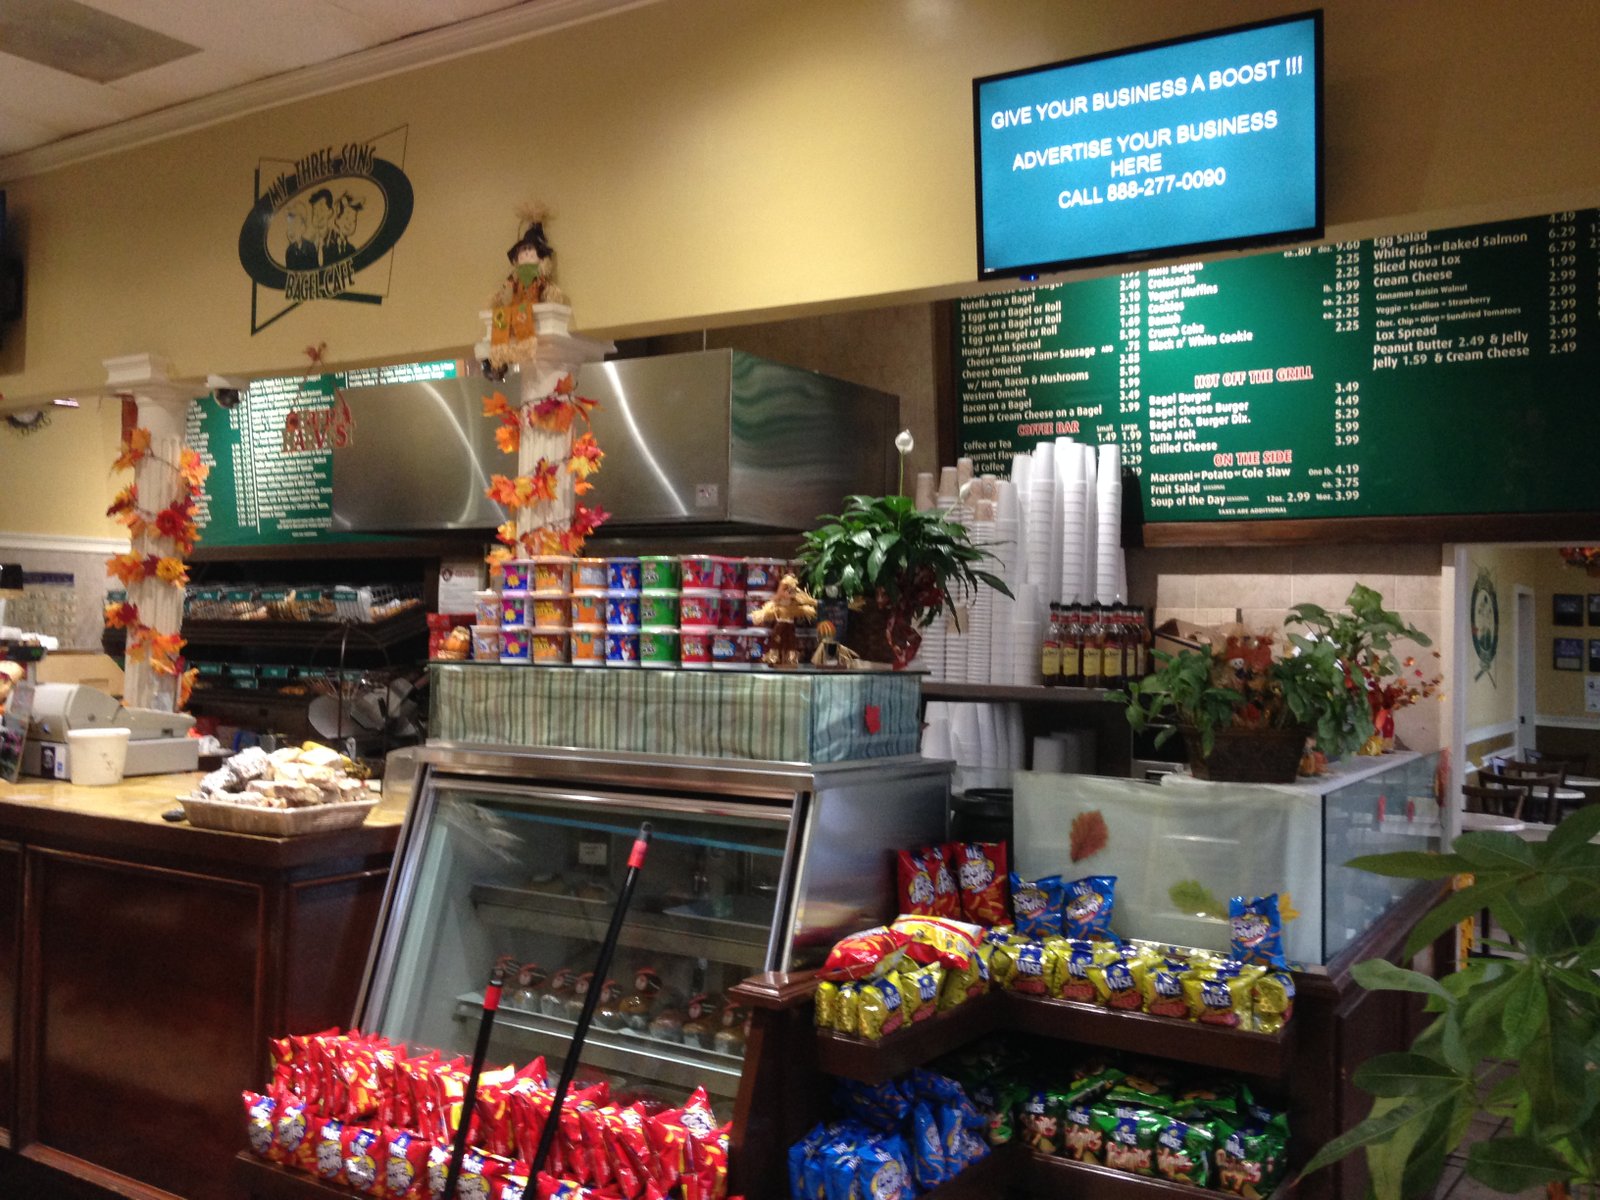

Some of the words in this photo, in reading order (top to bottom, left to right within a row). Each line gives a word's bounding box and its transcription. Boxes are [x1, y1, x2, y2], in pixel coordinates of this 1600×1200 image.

[991, 107, 1032, 130] GIVE
[1036, 96, 1088, 120] YOUR
[1092, 78, 1186, 112] BUSINESS
[1190, 74, 1204, 94] A
[1209, 59, 1280, 90] BOOST
[1286, 56, 1303, 77] !!!
[1012, 138, 1112, 171] ADVERTISE
[1117, 128, 1172, 154] YOUR
[1177, 110, 1278, 144] BUSINESS
[294, 146, 334, 190] THREE
[340, 143, 376, 175] SONS
[1111, 153, 1162, 178] HERE
[1058, 186, 1102, 210] CALL
[1107, 167, 1226, 202] 888-277-0090
[1374, 247, 1406, 260] White
[1410, 244, 1432, 256] Fish
[1443, 239, 1479, 252] Baked
[1483, 232, 1528, 247] Salmon
[1549, 226, 1575, 239] 6.29
[1374, 262, 1406, 274] Sliced
[1410, 258, 1438, 270] Nova
[1441, 256, 1461, 266] Lox
[1549, 241, 1575, 253] 6.79
[1148, 274, 1196, 289] Croissants
[1336, 253, 1360, 265] 2.25
[1374, 275, 1408, 287] Cream
[1412, 270, 1452, 284] Cheese
[1550, 255, 1576, 268] 1.99
[286, 270, 322, 300] BAGEL
[1148, 288, 1179, 303] Yogurt
[1181, 284, 1218, 298] Muffins
[1336, 267, 1360, 279] 2.25
[1148, 301, 1185, 314] Cookies
[1336, 280, 1360, 292] 8.99
[1376, 290, 1413, 301] Cinnamon
[1416, 287, 1439, 297] Raisin
[1441, 284, 1468, 294] Walnut
[1549, 270, 1576, 282] 2.99
[961, 300, 989, 311] Nutella
[1011, 292, 1035, 305] Bagel
[1008, 304, 1032, 317] Bagel
[1045, 300, 1062, 312] Roll
[1148, 313, 1181, 327] Danish
[1336, 293, 1359, 306] 2.25
[1376, 304, 1401, 315] Veggie
[1410, 301, 1439, 310] Scallion
[1448, 296, 1490, 308] Strawberry
[1549, 284, 1576, 296] 2.99
[1008, 316, 1032, 329] Bagel
[1045, 312, 1062, 324] Roll
[1148, 325, 1179, 339] Crumb
[1181, 322, 1205, 336] Cake
[1336, 307, 1359, 319] 2.25
[1376, 319, 1395, 328] Choc.
[1397, 316, 1414, 327] Chip
[1420, 314, 1439, 324] Olive
[1446, 310, 1481, 321] Sundried
[1484, 306, 1521, 316] Tomatoes
[1549, 299, 1576, 311] 2.99
[1004, 328, 1028, 341] Bagel
[1041, 324, 1057, 336] Roll
[1148, 338, 1174, 352] Black
[1188, 334, 1217, 347] White
[1219, 330, 1253, 343] Cookie
[1336, 320, 1359, 332] 2.25
[1376, 330, 1395, 341] Lox
[1398, 324, 1437, 338] Spread
[1549, 313, 1576, 325] 3.49
[962, 346, 990, 358] Hungry
[992, 344, 1010, 353] Man
[1012, 340, 1041, 353] Special
[1374, 343, 1413, 355] Peanut
[1417, 338, 1452, 350] Butter
[1458, 336, 1484, 348] 2.49
[1502, 331, 1528, 345] Jelly
[1549, 328, 1576, 340] 2.99
[966, 357, 994, 367] Cheese
[1001, 354, 1026, 364] Bacon
[1033, 351, 1052, 361] Ham
[1060, 346, 1095, 359] Sausage
[1373, 356, 1398, 370] Jelly
[1402, 355, 1427, 366] 1.59
[1435, 353, 1443, 363] &
[1446, 349, 1483, 363] Cream
[1487, 346, 1530, 359] Cheese
[1550, 342, 1576, 354] 2.49
[962, 368, 989, 379] Cheese
[992, 366, 1022, 376] Omelet
[981, 377, 1002, 389] Ham,
[1005, 376, 1029, 386] Bacon
[1040, 371, 1089, 383] Mushrooms
[1194, 374, 1220, 389] HOT
[1223, 372, 1247, 387] OFF
[1249, 370, 1273, 384] THE
[1276, 366, 1313, 382] GRILL
[963, 391, 994, 402] Western
[996, 389, 1026, 399] Omelet
[963, 403, 986, 412] Bacon
[1009, 398, 1031, 411] Bagel
[1149, 394, 1176, 407] Bagel
[1178, 392, 1211, 405] Burger
[1335, 382, 1359, 394] 3.49
[963, 414, 986, 424] Bacon
[997, 412, 1022, 421] Cream
[1024, 409, 1054, 420] Cheese
[1077, 404, 1102, 417] Bagel
[1149, 406, 1176, 419] Bagel
[1178, 404, 1212, 416] Cheese
[1215, 402, 1249, 415] Burger
[1335, 395, 1359, 406] 4.49
[1056, 421, 1080, 434] BAR
[1149, 419, 1176, 432] Bagel
[1196, 415, 1229, 428] Burger
[1335, 408, 1359, 420] 5.29
[1149, 432, 1172, 443] Tuna
[1175, 429, 1196, 441] Melt
[1335, 422, 1359, 433] 5.99
[964, 440, 989, 450] Coffee
[999, 440, 1012, 448] Tea
[1150, 443, 1181, 455] Grilled
[1183, 442, 1217, 453] Cheese
[1335, 435, 1359, 446] 3.99
[982, 463, 1004, 471] Coffee
[1214, 454, 1232, 467] ON
[1235, 452, 1260, 466] THE
[1263, 450, 1292, 464] SIDE
[1150, 471, 1193, 483] Macaroni
[1202, 470, 1234, 480] Potato
[1242, 468, 1264, 478] Cole
[1266, 466, 1290, 477] Slaw
[1335, 464, 1359, 475] 4.19
[1150, 484, 1171, 494] Fruit
[1174, 483, 1200, 493] Salad
[1335, 478, 1359, 488] 3.75
[1150, 496, 1174, 507] Soup
[1176, 495, 1187, 505] of
[1189, 495, 1203, 505] the
[1207, 494, 1226, 506] Day
[1287, 492, 1310, 502] 2.99
[1335, 491, 1359, 501] 3.99
[1106, 976, 1133, 990] WISE
[1201, 993, 1231, 1007] WISE
